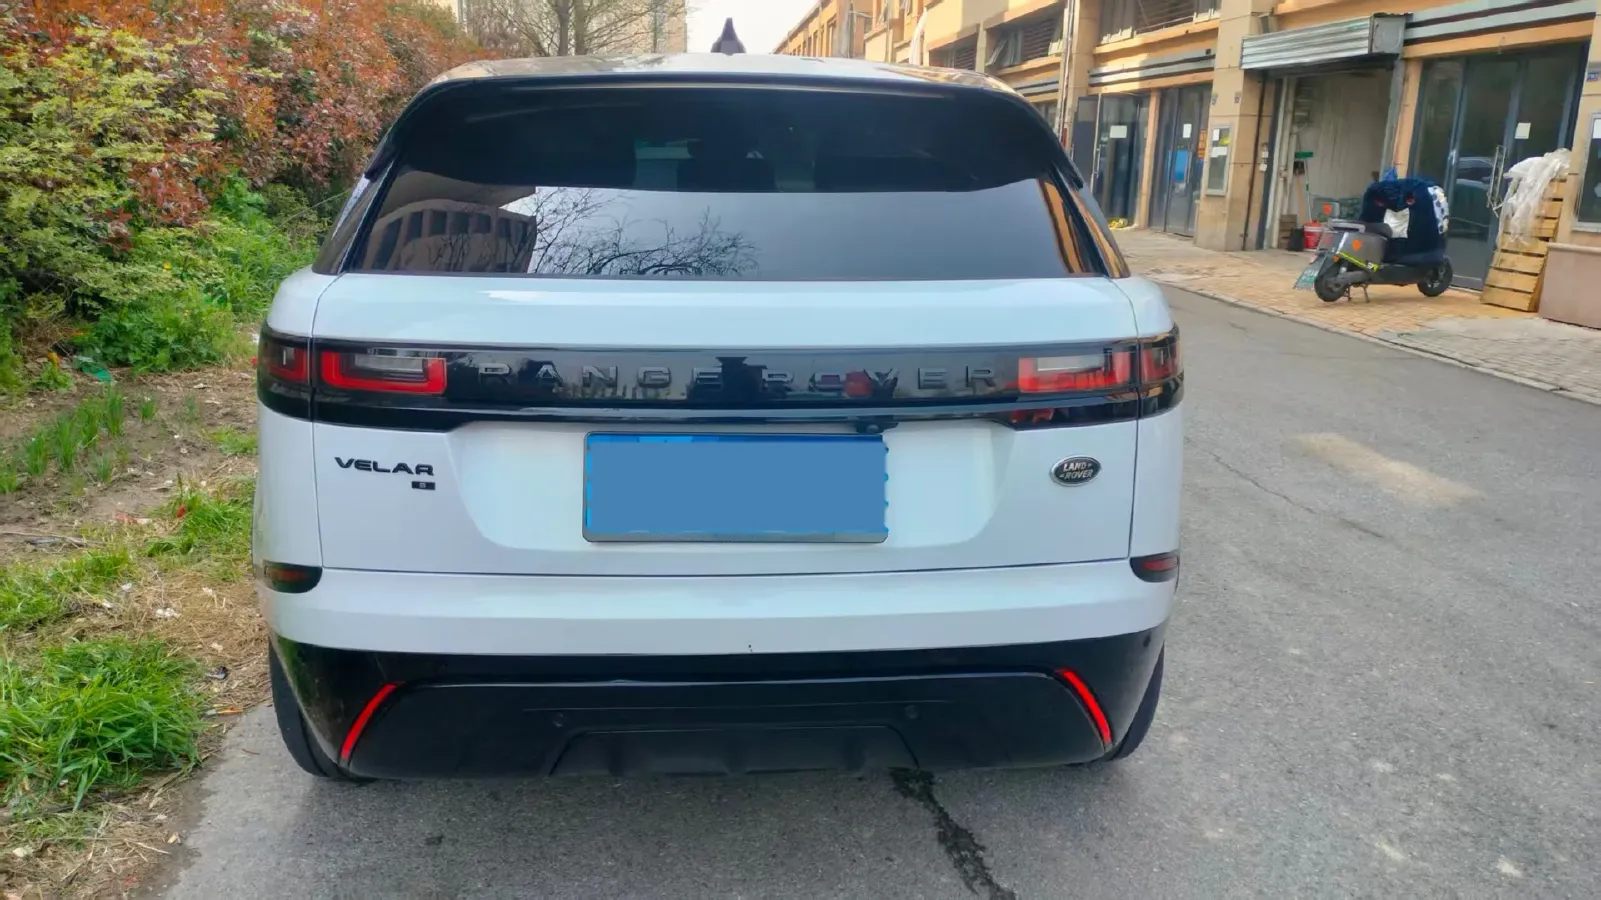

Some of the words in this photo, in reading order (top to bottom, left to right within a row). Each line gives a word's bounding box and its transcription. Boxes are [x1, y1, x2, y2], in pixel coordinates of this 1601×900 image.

[478, 362, 723, 389] RANGE
[762, 365, 997, 391] ROVER
[335, 457, 434, 476] VELAR
[1063, 462, 1087, 472] LAND
[1064, 470, 1094, 480] ROVER
